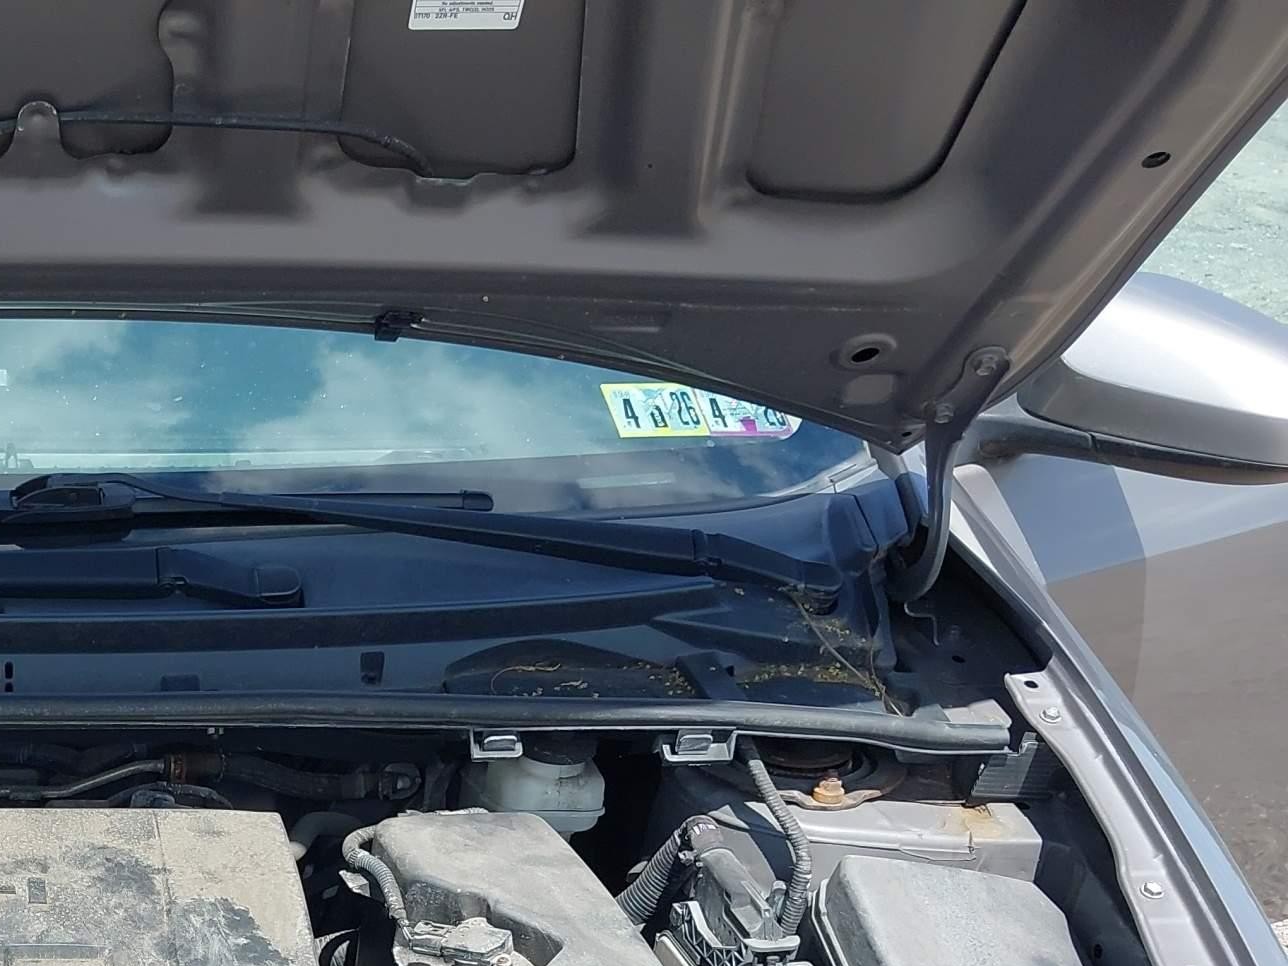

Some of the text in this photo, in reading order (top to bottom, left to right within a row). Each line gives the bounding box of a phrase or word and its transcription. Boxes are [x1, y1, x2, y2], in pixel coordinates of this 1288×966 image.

[622, 391, 701, 429] 4 26
[709, 397, 728, 428] 4
